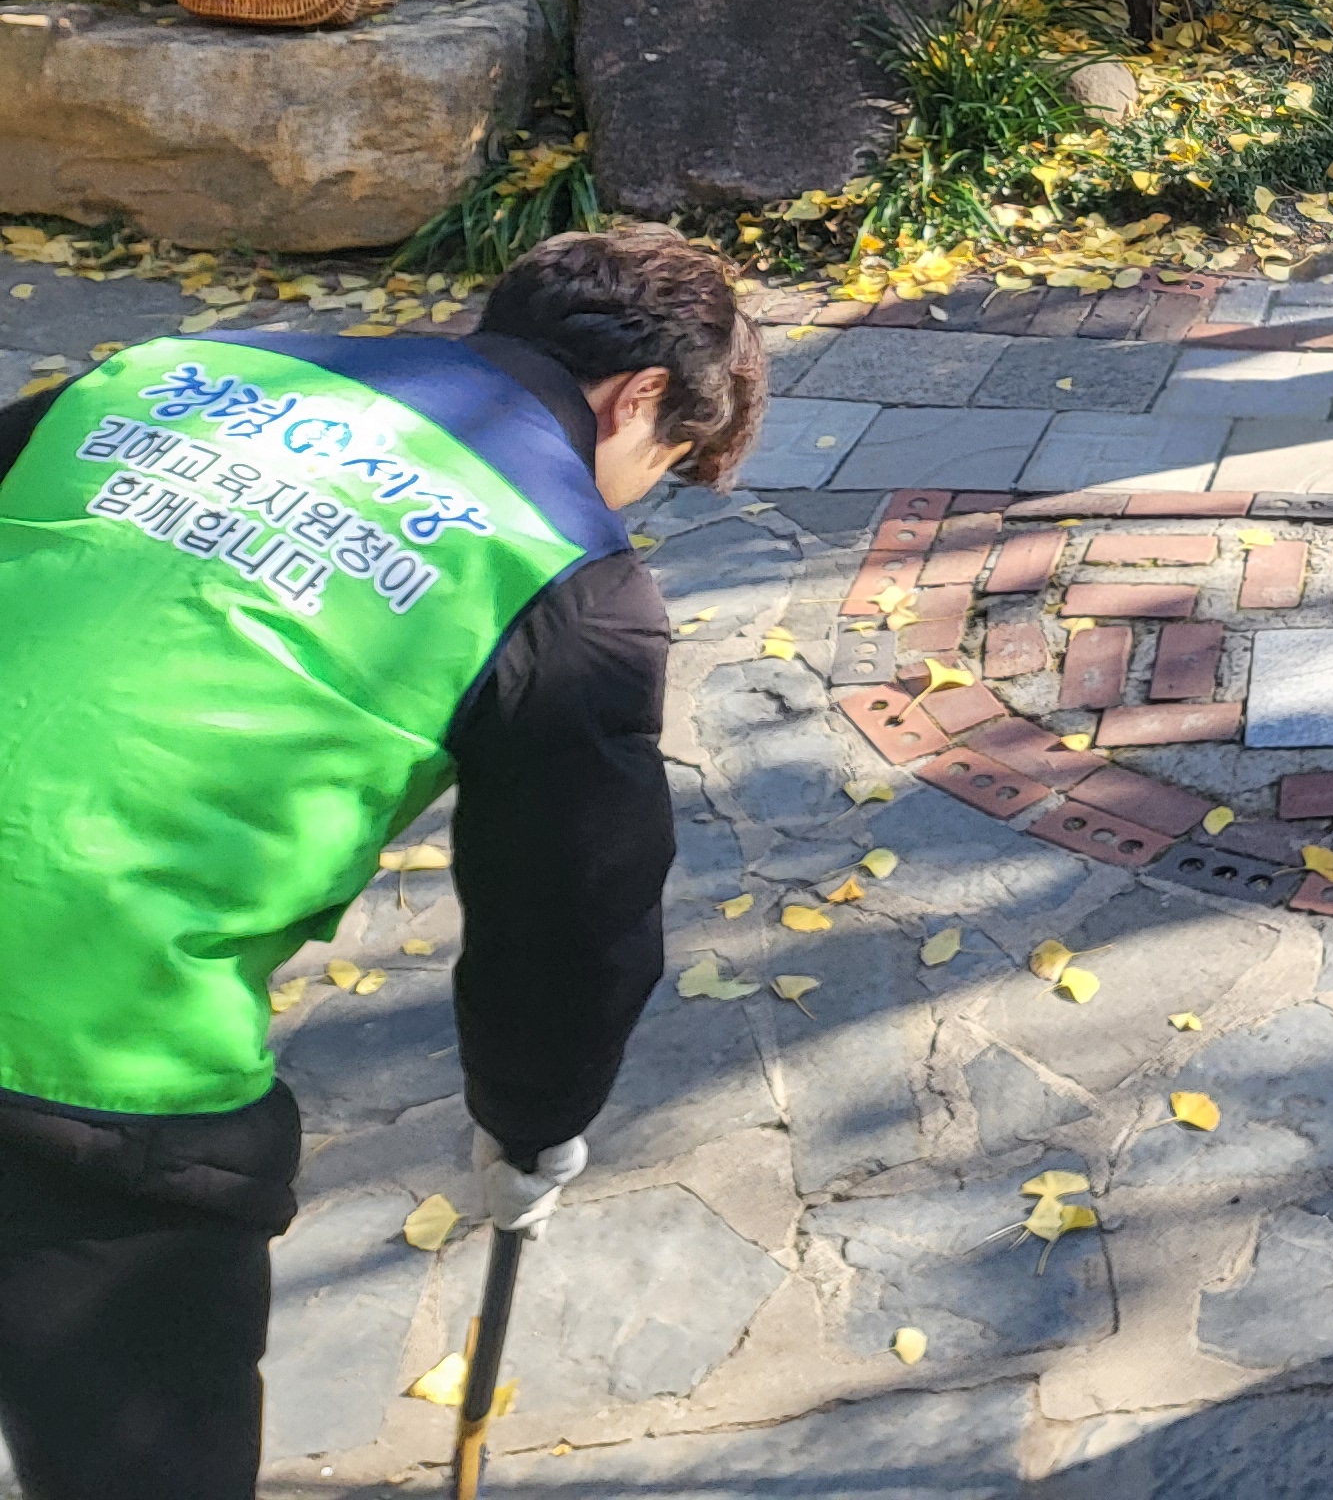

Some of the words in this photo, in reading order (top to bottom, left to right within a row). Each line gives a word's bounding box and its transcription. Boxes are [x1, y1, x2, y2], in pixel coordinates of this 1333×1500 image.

[145, 366, 297, 439] 청렴
[84, 419, 437, 609] 김해교육지원청이
[93, 476, 325, 608] 함께합니다.
